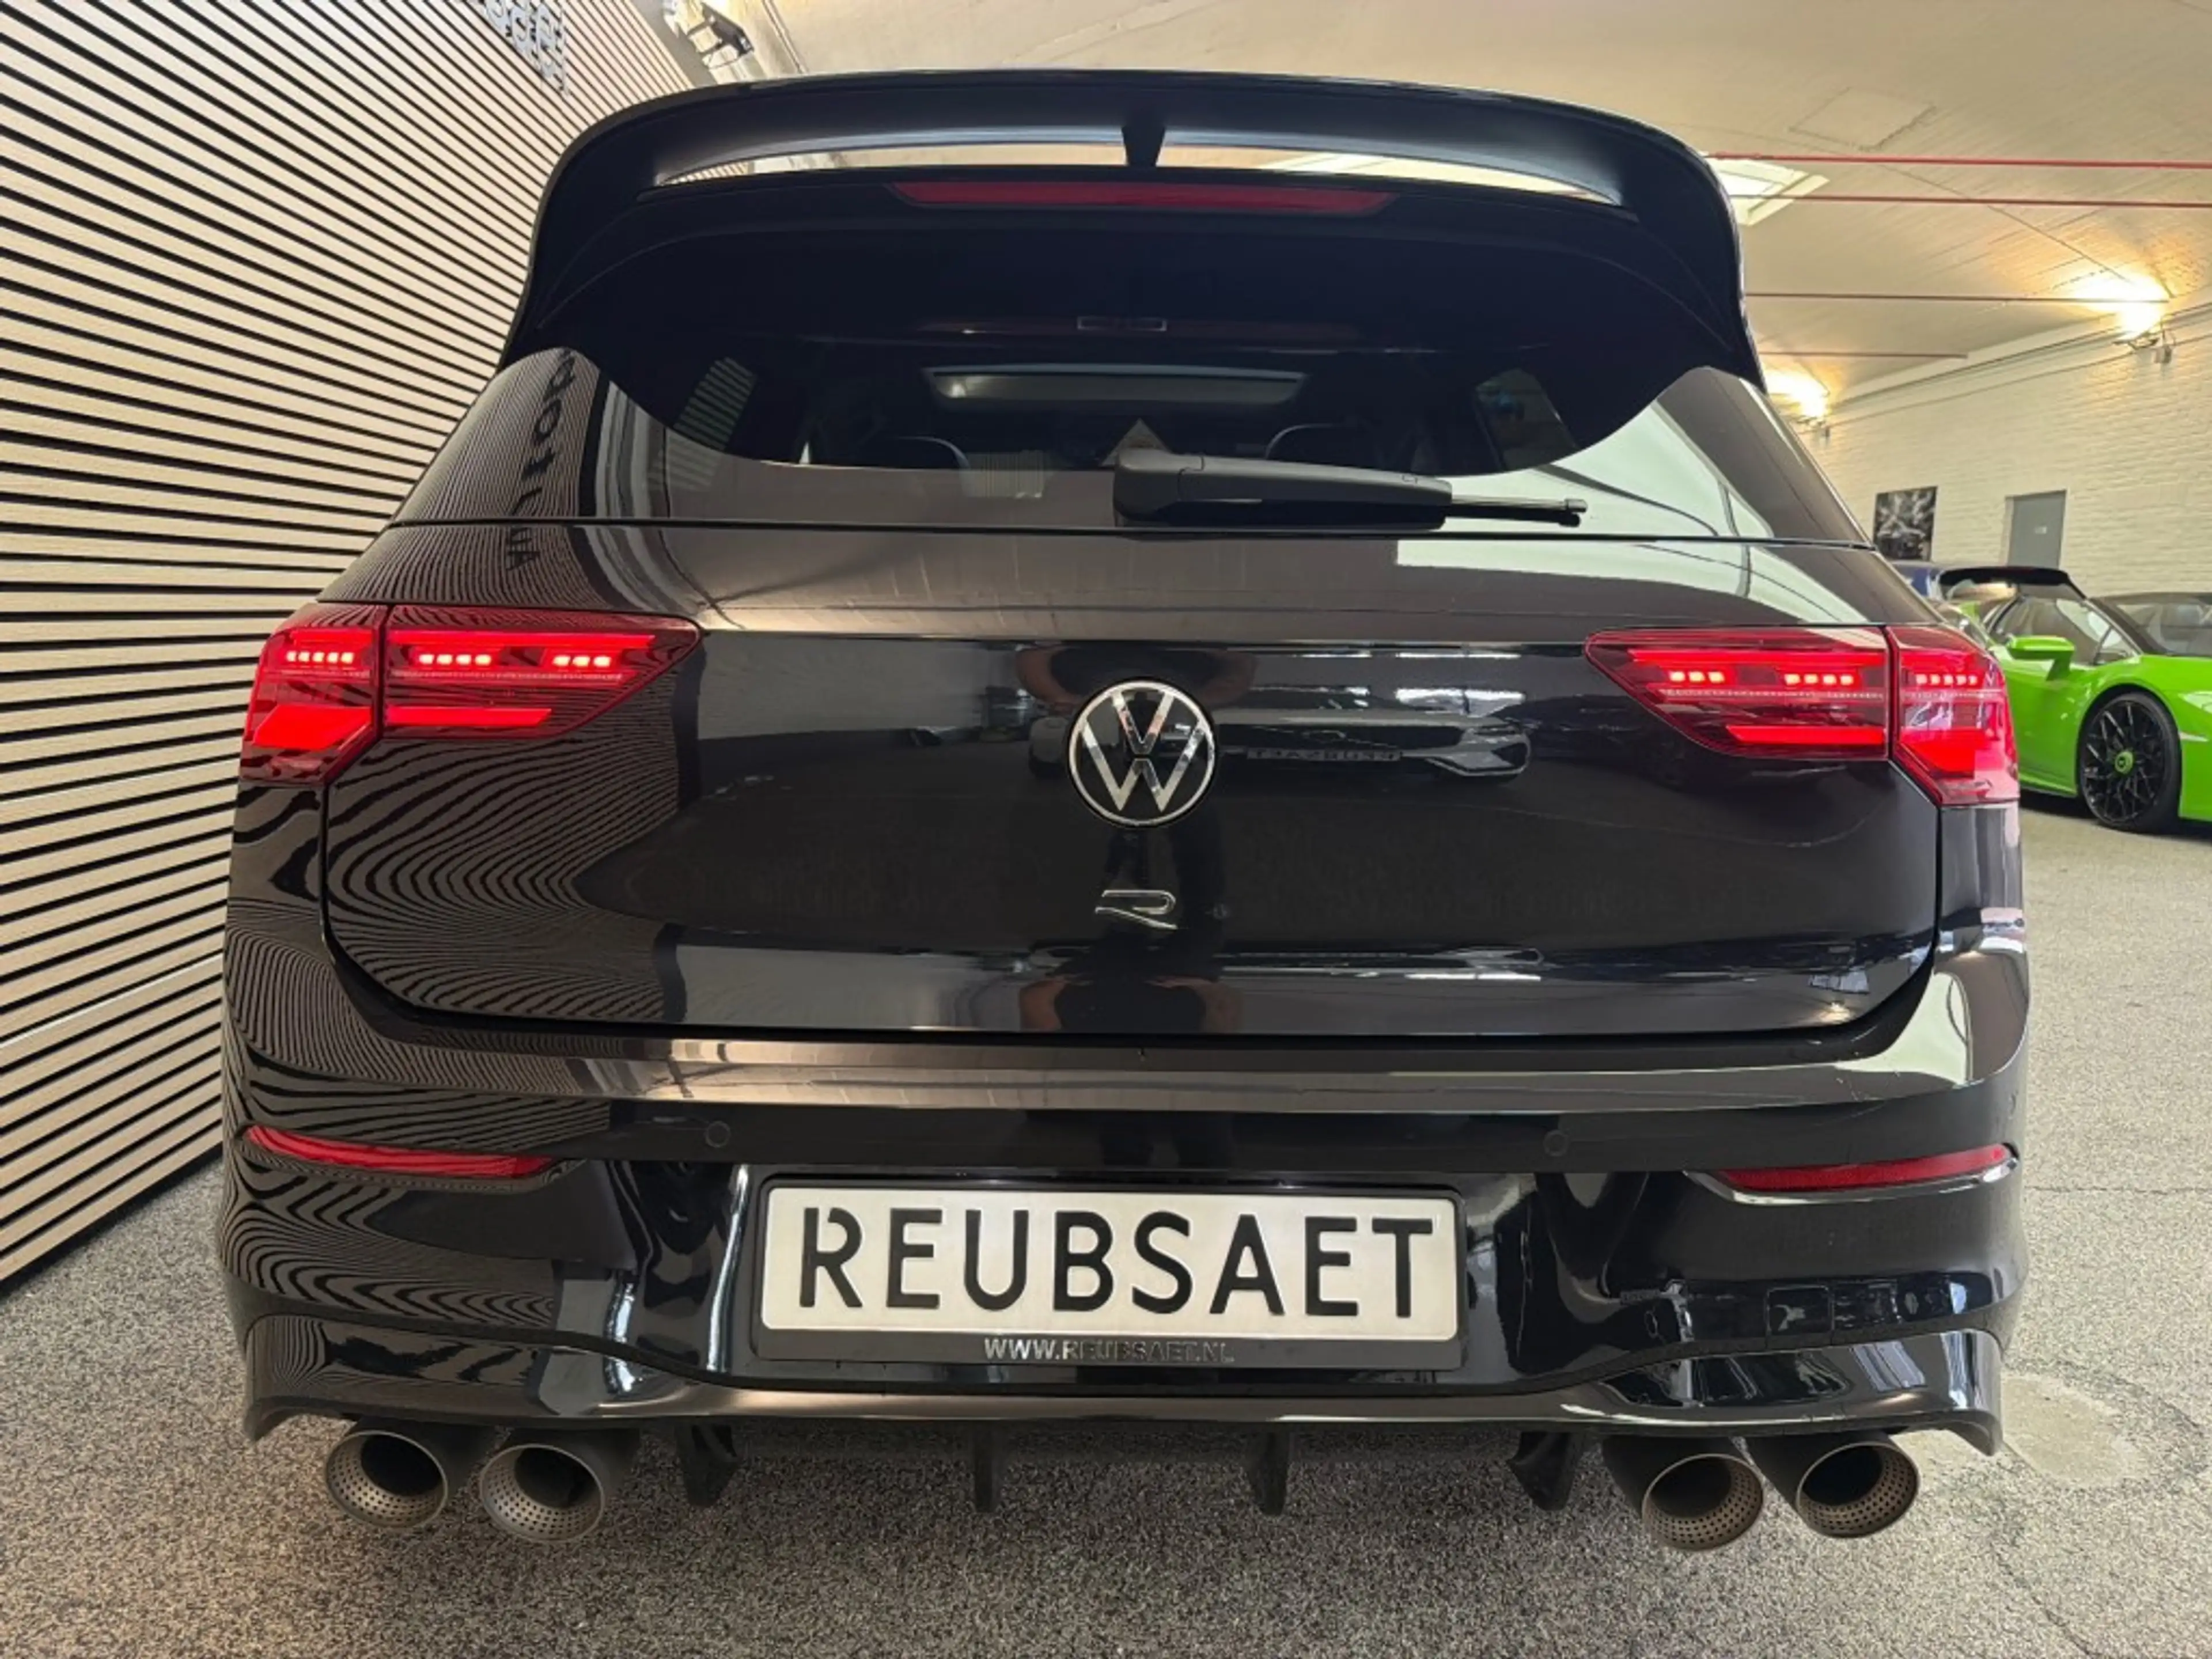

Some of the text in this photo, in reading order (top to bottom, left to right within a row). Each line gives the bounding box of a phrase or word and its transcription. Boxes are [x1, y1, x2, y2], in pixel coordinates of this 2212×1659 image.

[1096, 889, 1177, 930] R
[798, 1206, 1433, 1319] REUBSAET
[984, 1337, 1236, 1363] WWW.REUBSAET.NL
